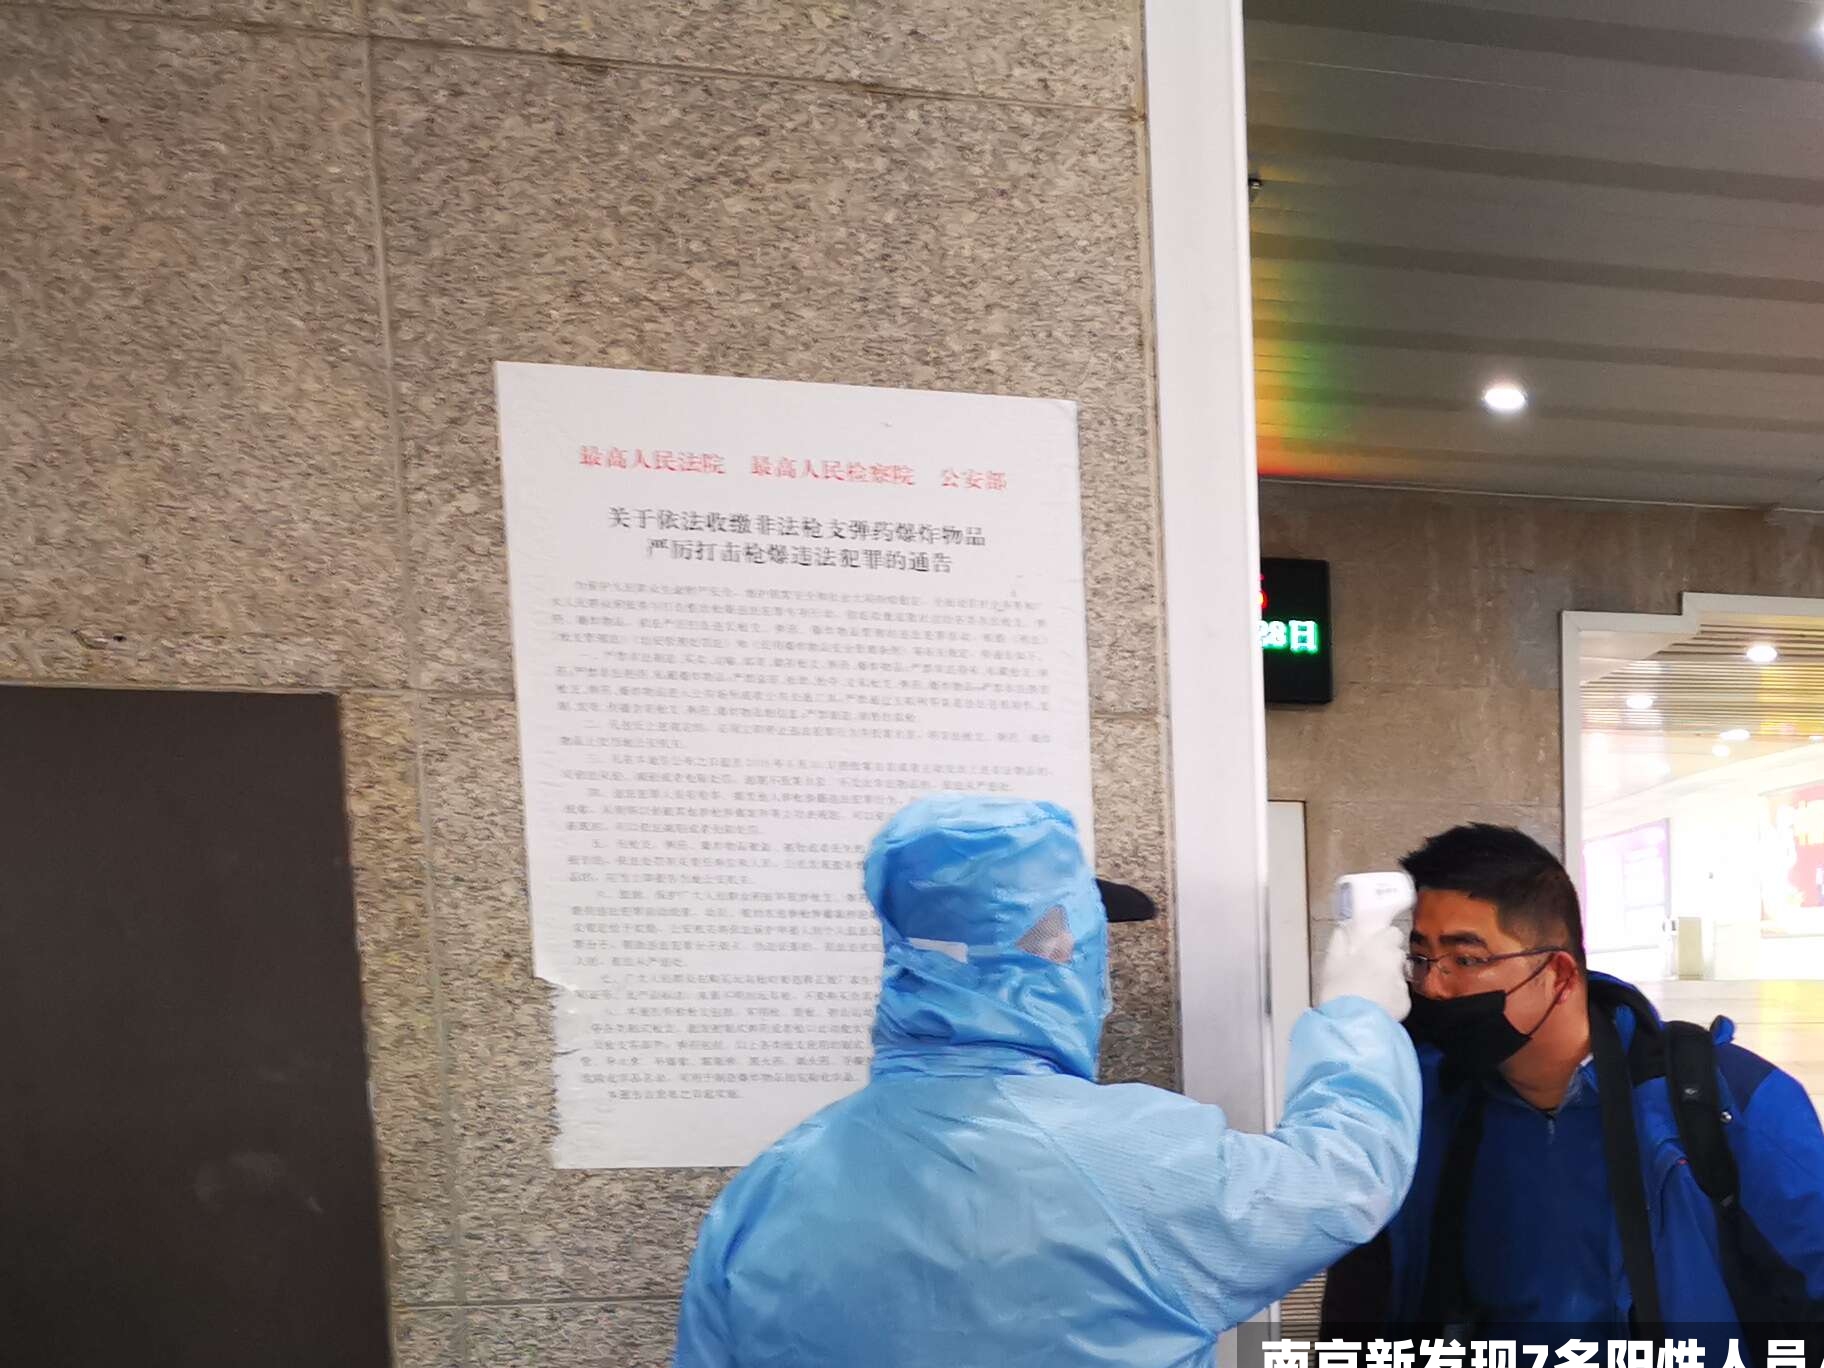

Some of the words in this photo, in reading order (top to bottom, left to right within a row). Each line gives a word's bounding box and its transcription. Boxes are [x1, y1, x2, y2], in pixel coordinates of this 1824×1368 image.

[579, 445, 726, 475] 最高人民法院
[751, 455, 916, 486] 最高人民检察院
[940, 468, 1008, 490] 公安部
[608, 505, 988, 547] 关于依法收缴非法枪支弹药爆炸物品
[645, 537, 954, 574] 严厉打击枪爆违法犯罪的通告
